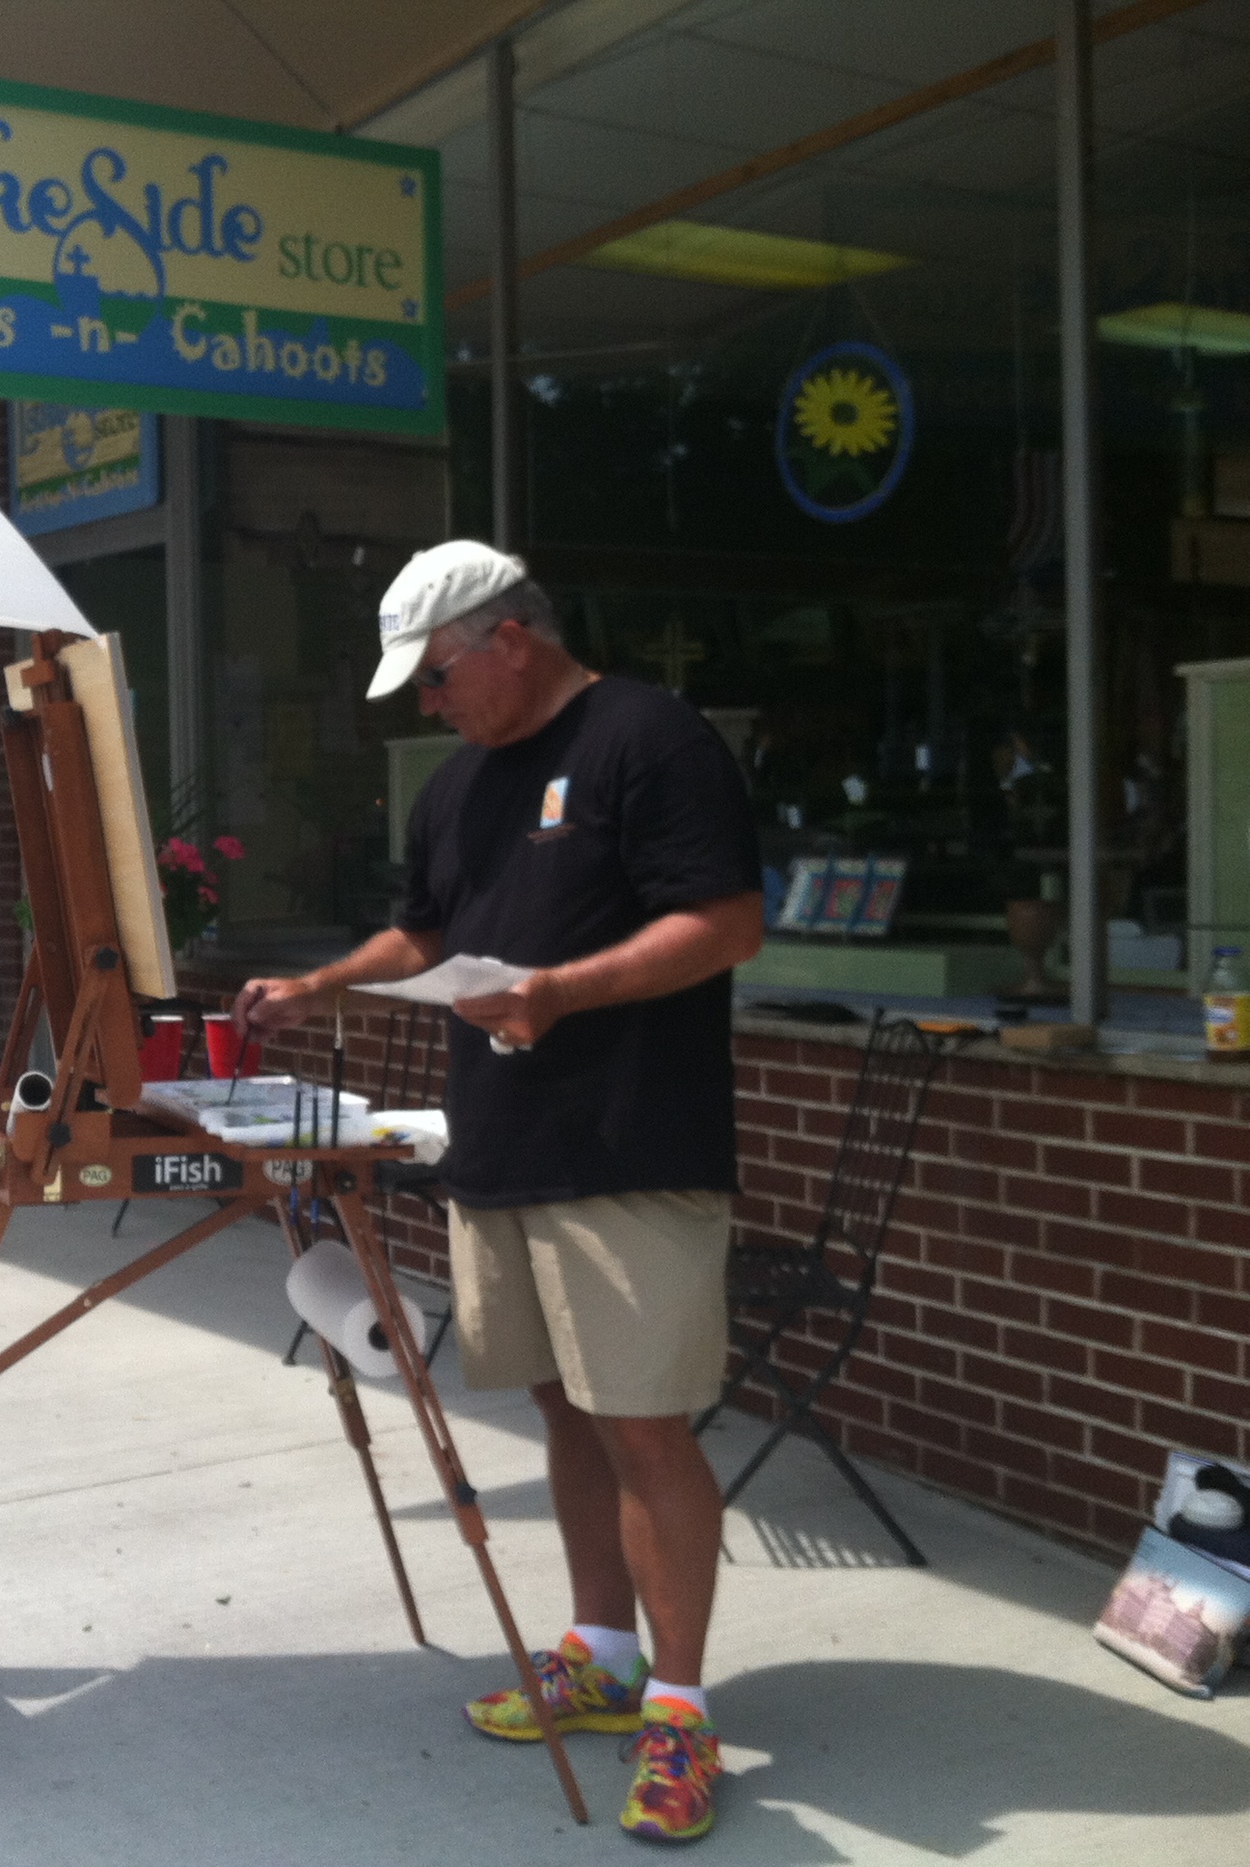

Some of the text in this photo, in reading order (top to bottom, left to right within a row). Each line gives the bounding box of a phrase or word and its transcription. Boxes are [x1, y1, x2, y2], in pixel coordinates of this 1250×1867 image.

[277, 229, 404, 291] store
[51, 315, 139, 353] -n-
[170, 302, 388, 388] Cahoots
[83, 1170, 108, 1181] PAG
[155, 1154, 222, 1184] iFish
